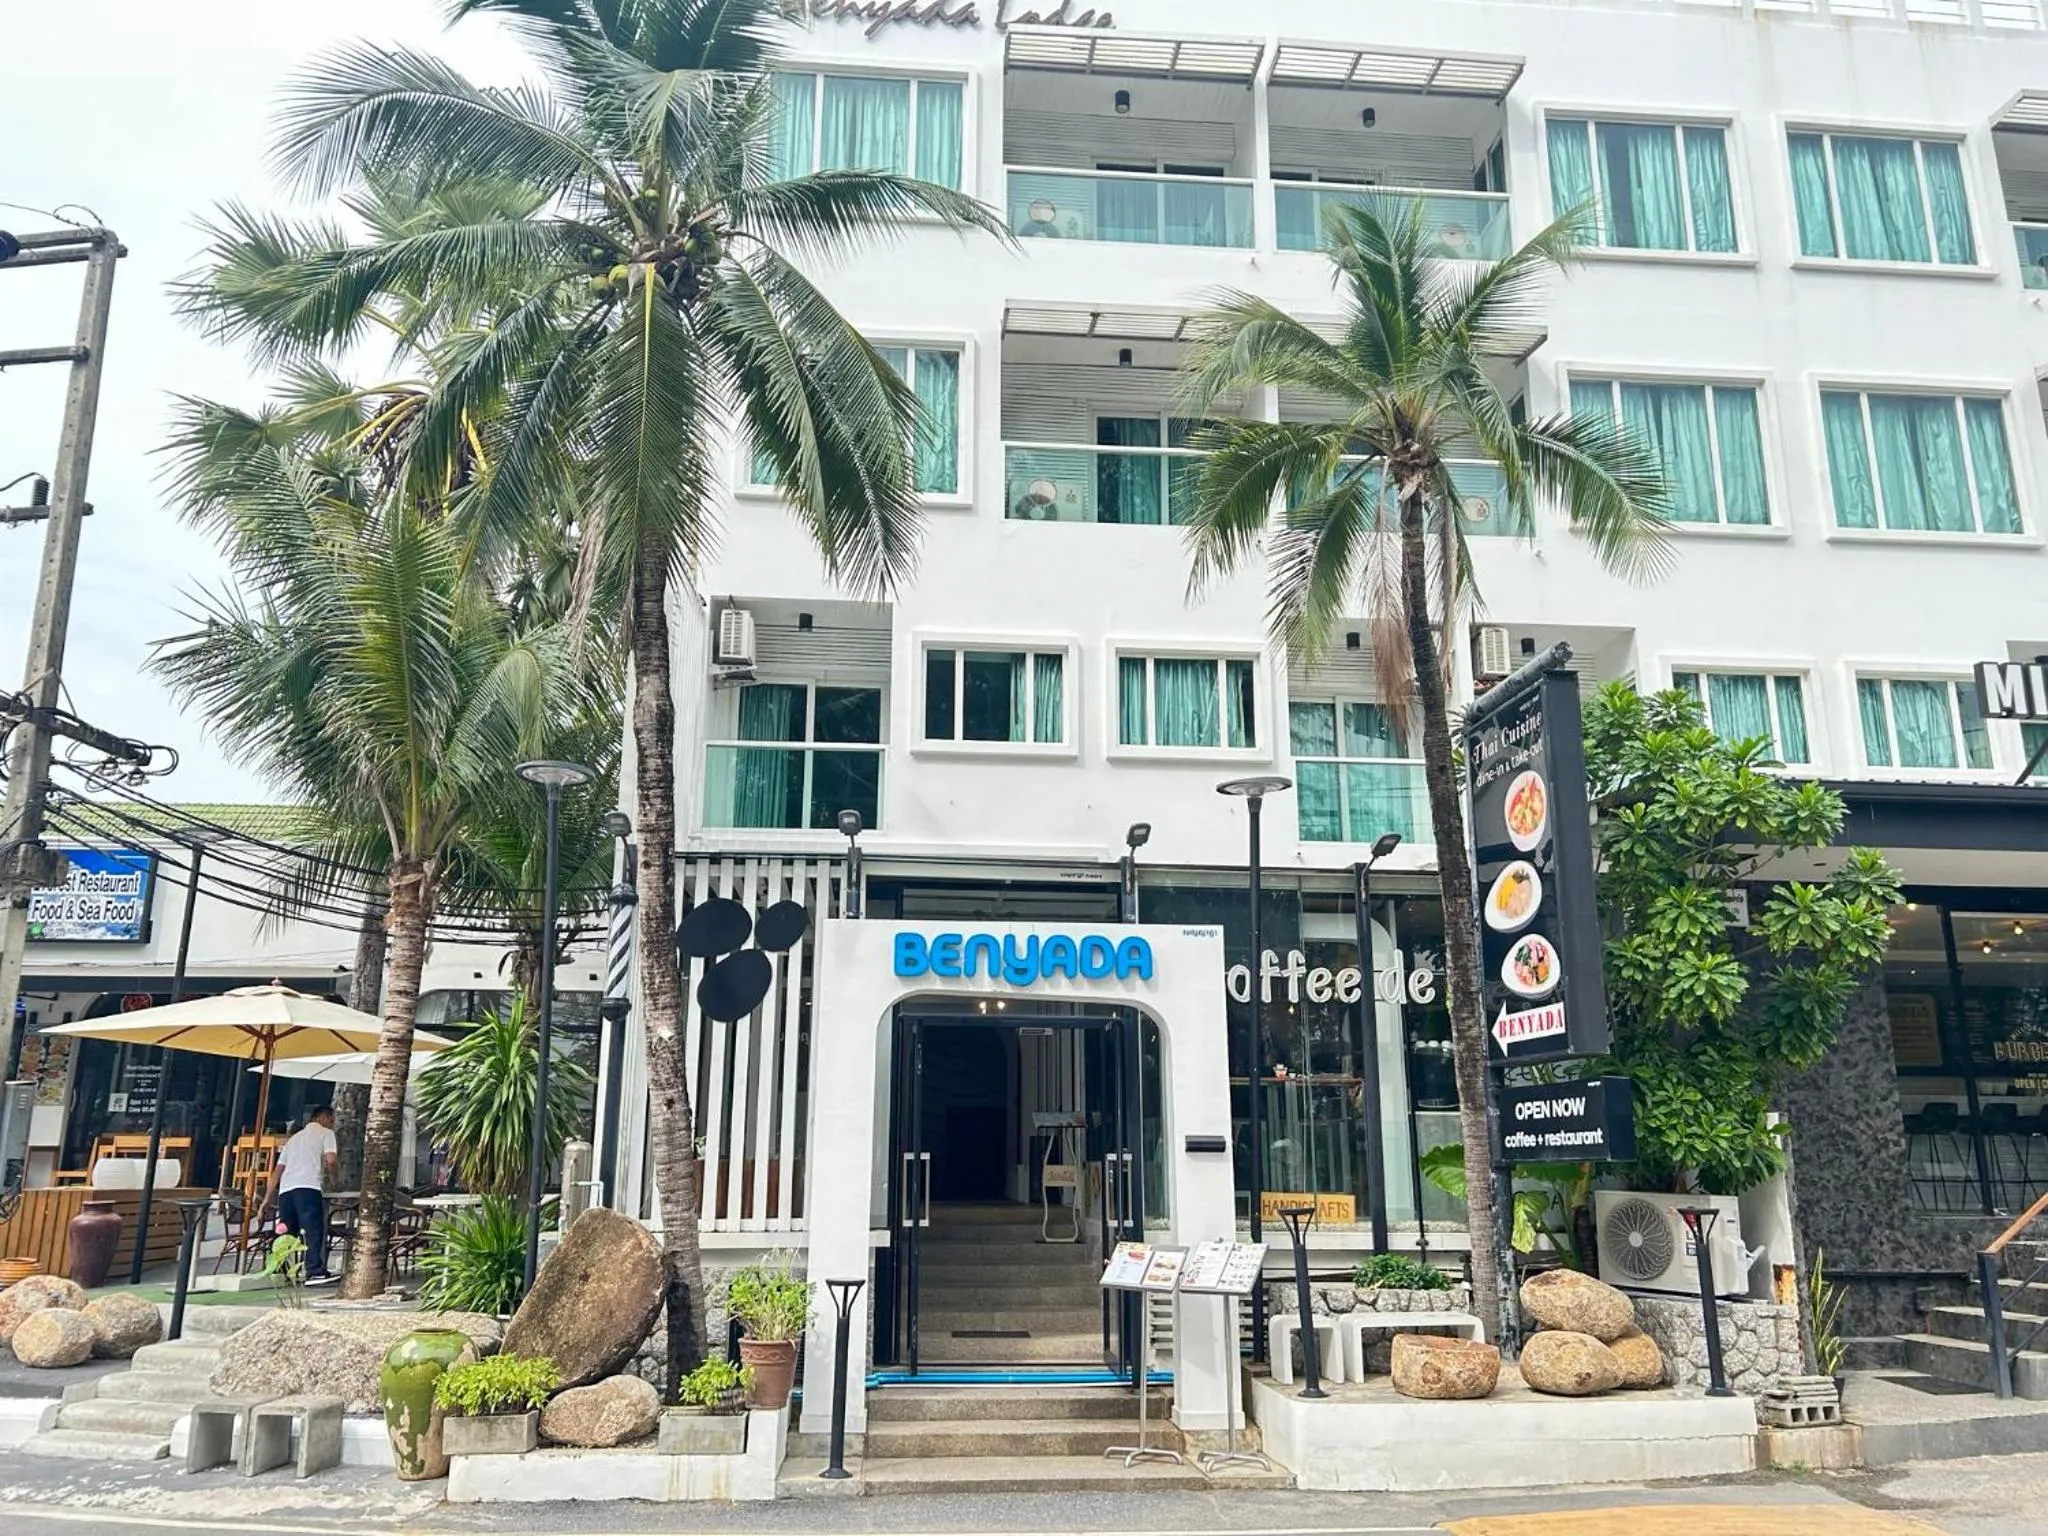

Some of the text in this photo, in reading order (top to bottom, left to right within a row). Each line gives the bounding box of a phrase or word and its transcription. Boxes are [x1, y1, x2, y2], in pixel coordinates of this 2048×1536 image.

[1473, 711, 1543, 764] Thai Cuisine
[80, 872, 139, 893] Restaurant
[32, 899, 136, 920] Food & Sea Food
[894, 932, 1153, 987] BENYADA
[1227, 949, 1363, 1003] offee
[1498, 1008, 1564, 1039] BENYADA
[1515, 1097, 1586, 1120] OPEN NOW
[1504, 1131, 1537, 1148] coffee
[1544, 1127, 1604, 1147] restaurant
